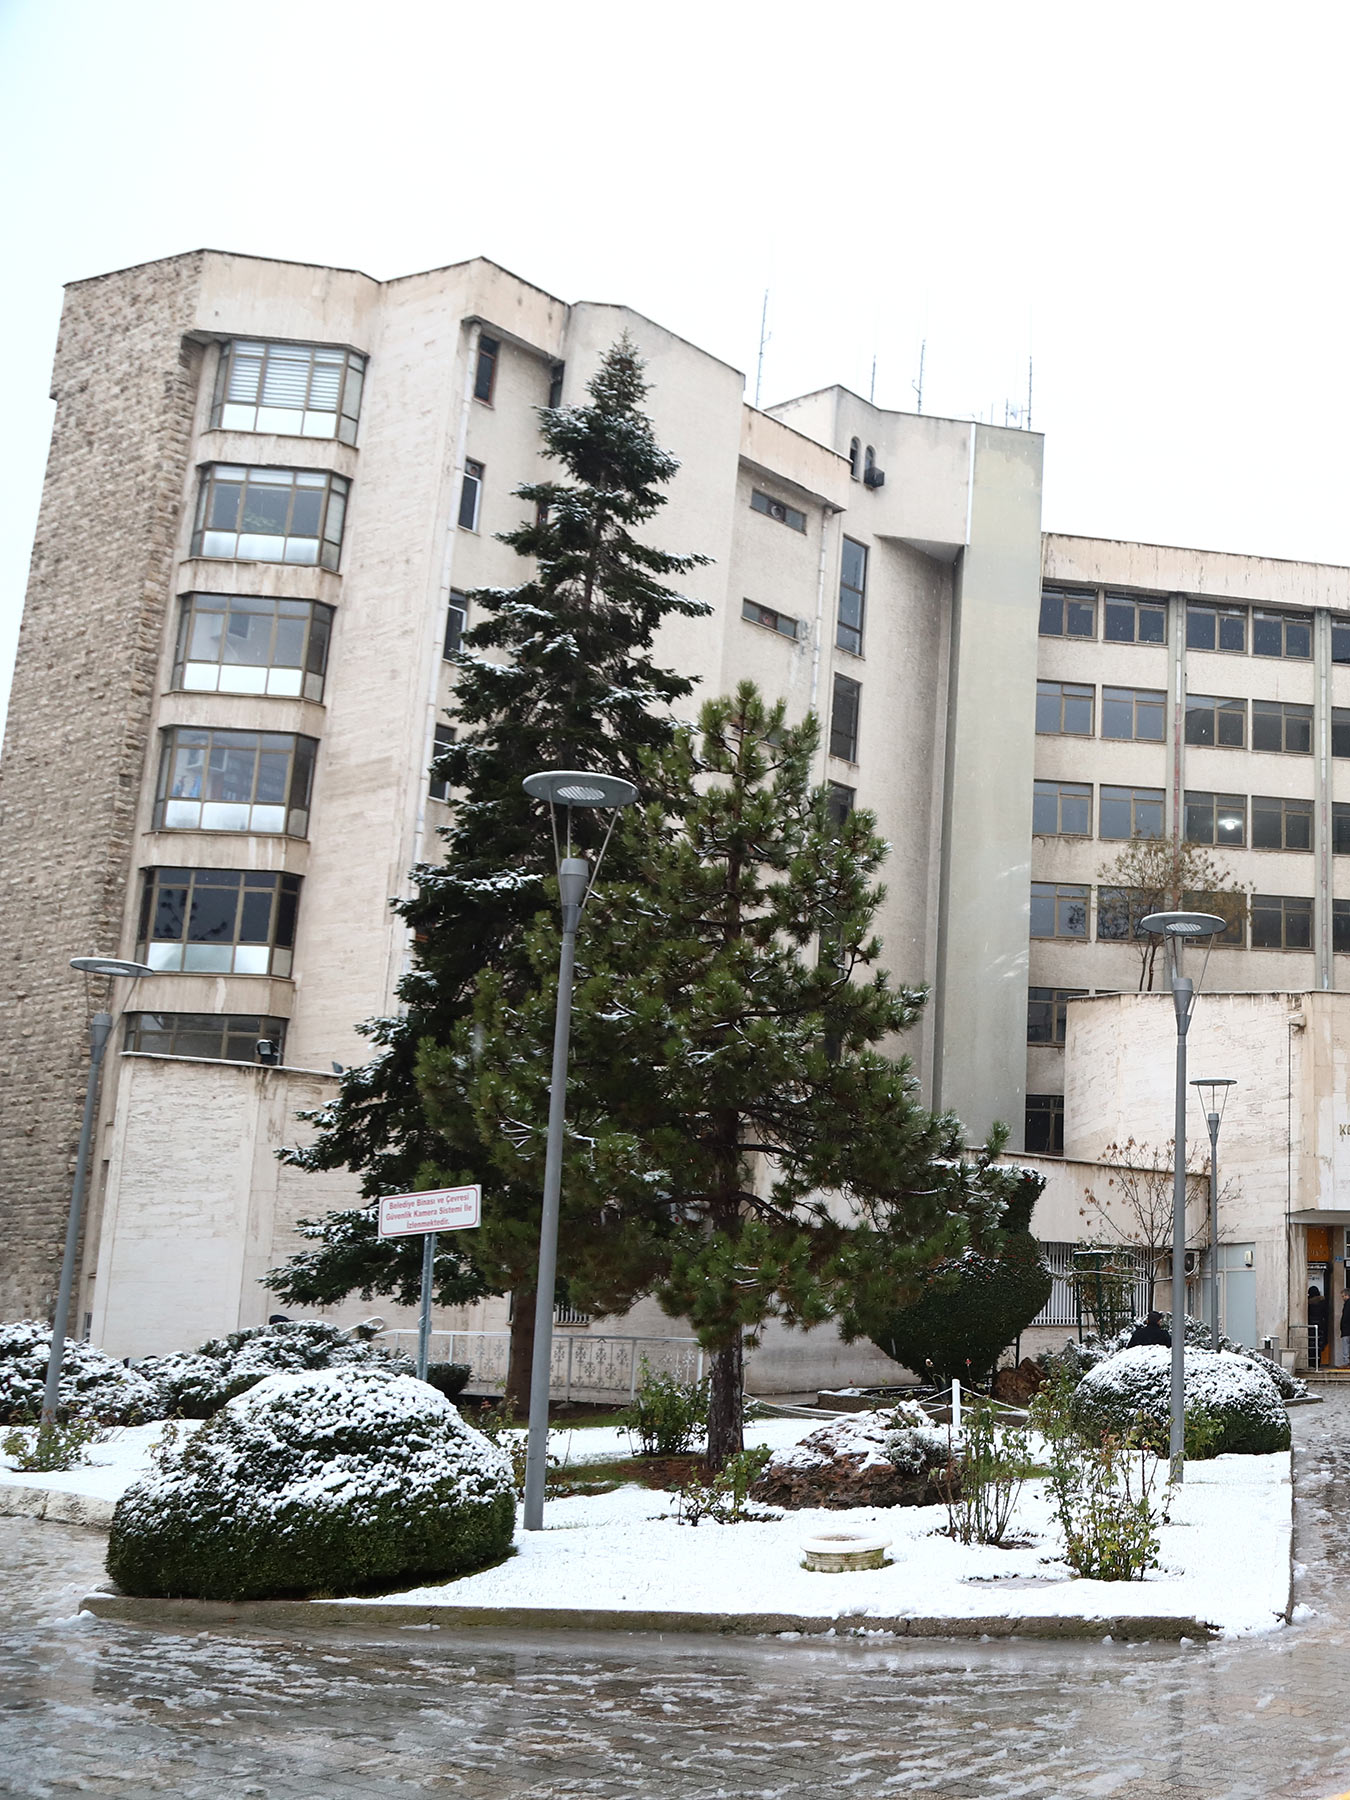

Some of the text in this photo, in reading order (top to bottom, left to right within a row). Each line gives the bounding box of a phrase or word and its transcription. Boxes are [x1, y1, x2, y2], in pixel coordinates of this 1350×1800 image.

[389, 1200, 415, 1210] Belediye
[416, 1199, 435, 1207] Binası
[445, 1194, 469, 1204] Çevresi
[386, 1212, 412, 1221] Güvenlik
[413, 1209, 437, 1217] Kamera
[438, 1205, 462, 1215] Sistemi
